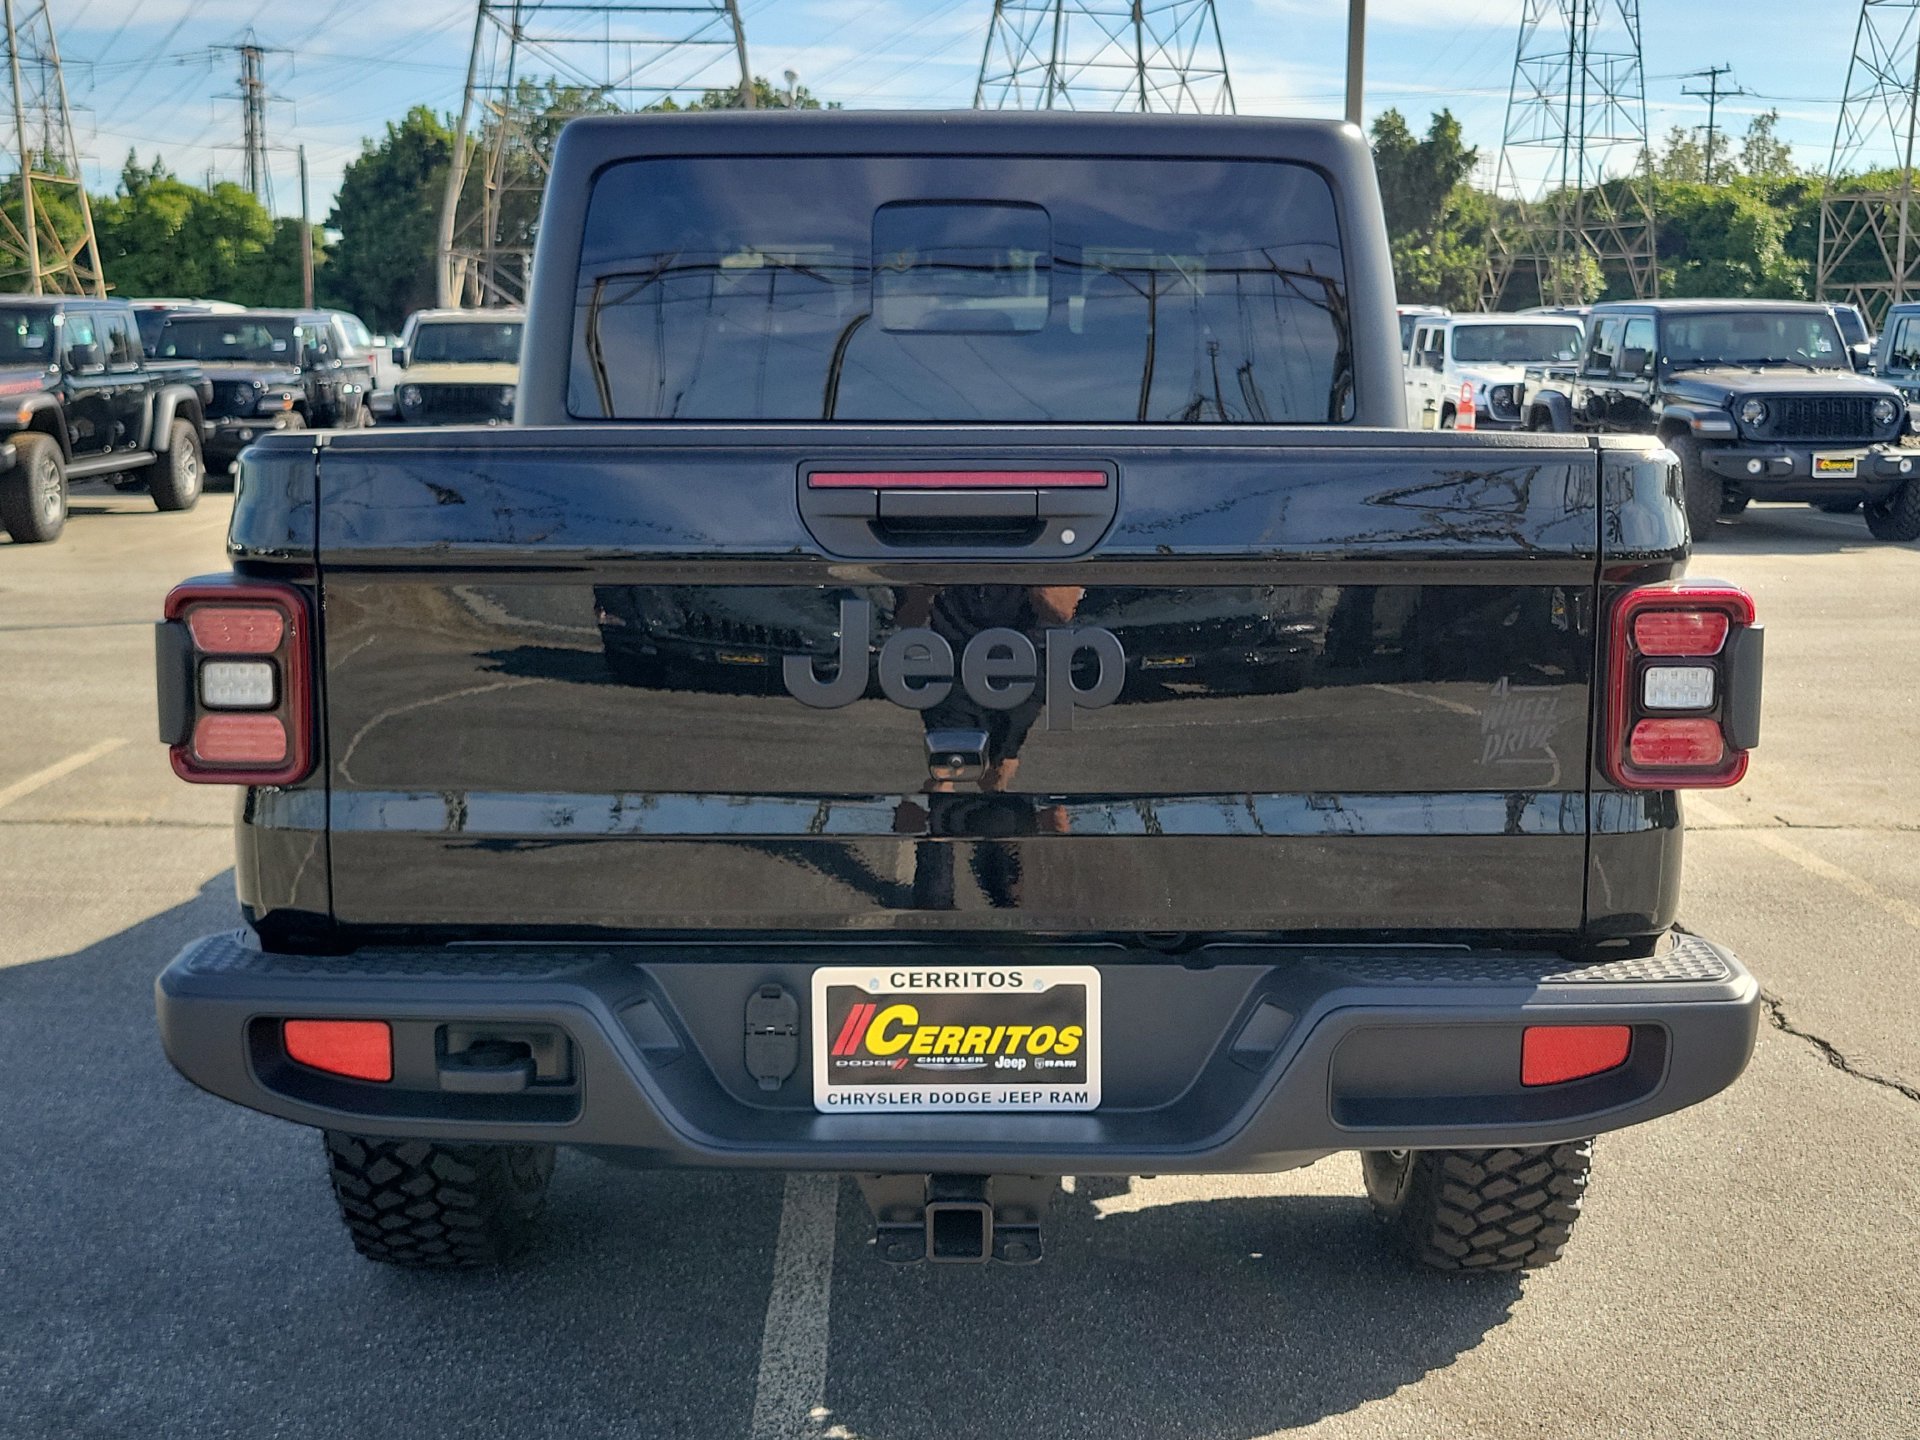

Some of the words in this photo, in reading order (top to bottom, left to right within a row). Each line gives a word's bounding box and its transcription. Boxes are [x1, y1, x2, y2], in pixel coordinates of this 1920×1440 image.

[783, 600, 1126, 731] Jeep
[1490, 676, 1511, 700] 4
[1481, 697, 1559, 734] WHEEL
[1481, 725, 1556, 765] DRIVE
[890, 971, 1024, 988] CERRITOS
[865, 1004, 1083, 1056] CERRITOS
[917, 1056, 985, 1064] CHRYSLER
[994, 1055, 1027, 1071] Jeep
[1044, 1059, 1078, 1068] RAM
[827, 1092, 923, 1106] CHRYSLER
[929, 1091, 992, 1105] DODGE
[998, 1091, 1043, 1104] JEEP
[1049, 1091, 1089, 1104] RAM
